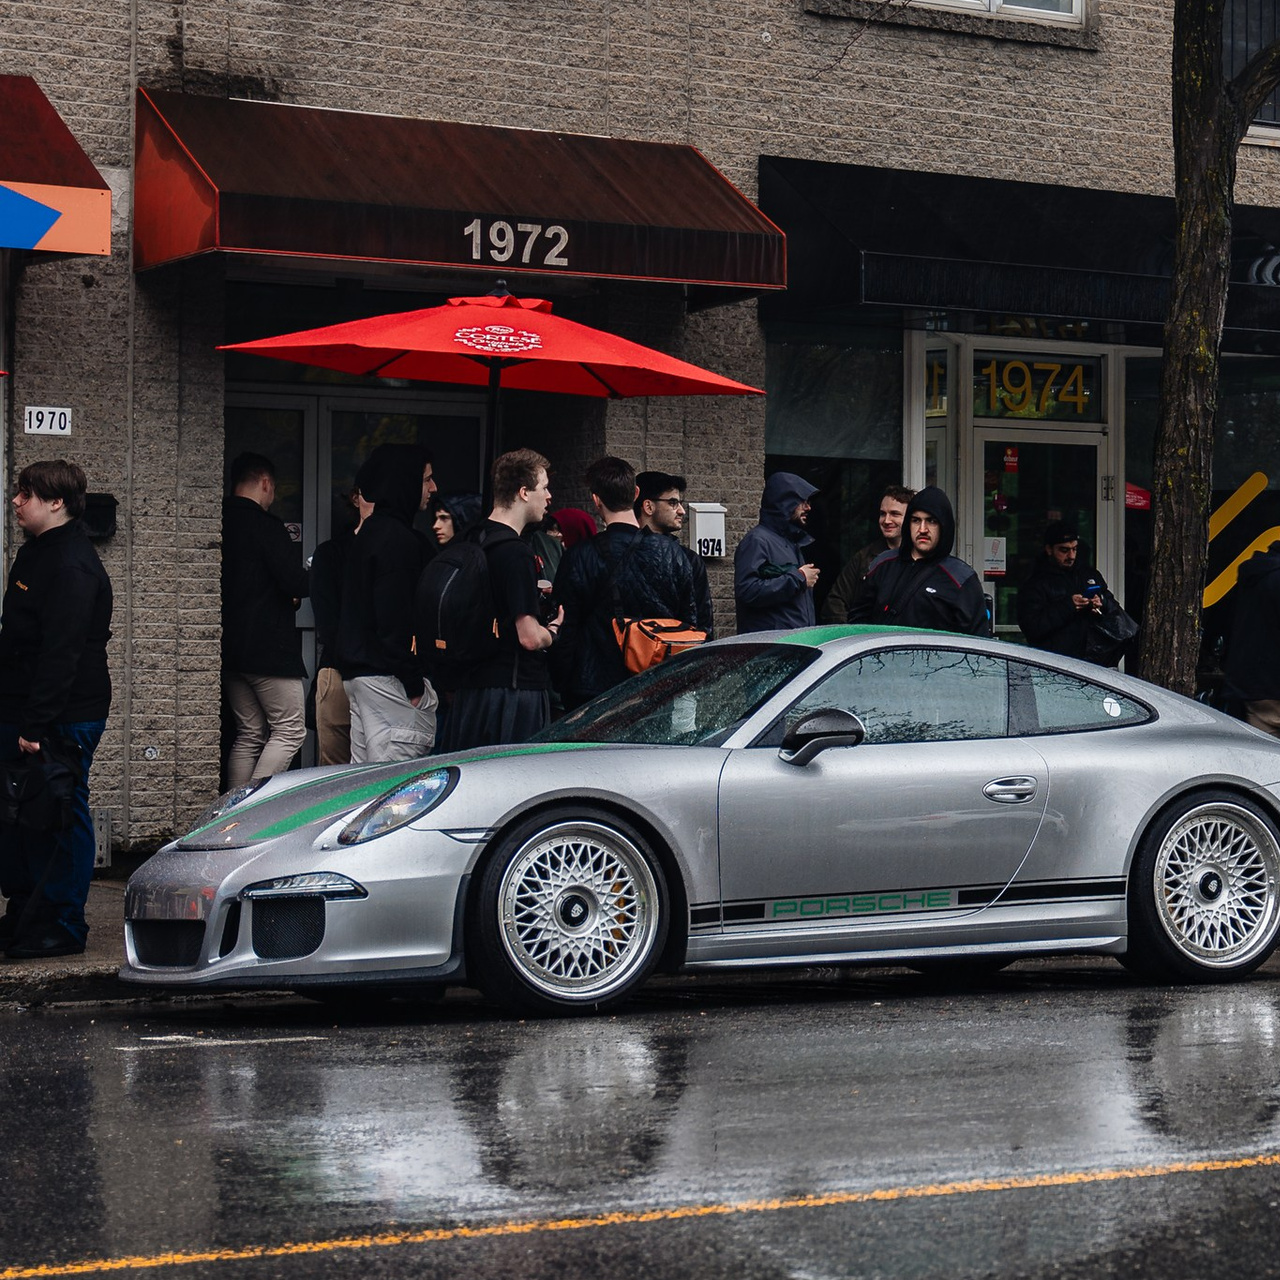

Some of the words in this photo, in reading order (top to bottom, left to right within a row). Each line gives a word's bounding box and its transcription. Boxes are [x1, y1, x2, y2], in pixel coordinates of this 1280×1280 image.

[464, 218, 569, 266] 1972
[455, 331, 541, 344] CORTESE
[982, 354, 1090, 415] 1974
[28, 410, 67, 431] 1970
[697, 537, 722, 556] 1974
[772, 891, 951, 918] PORSCHE
